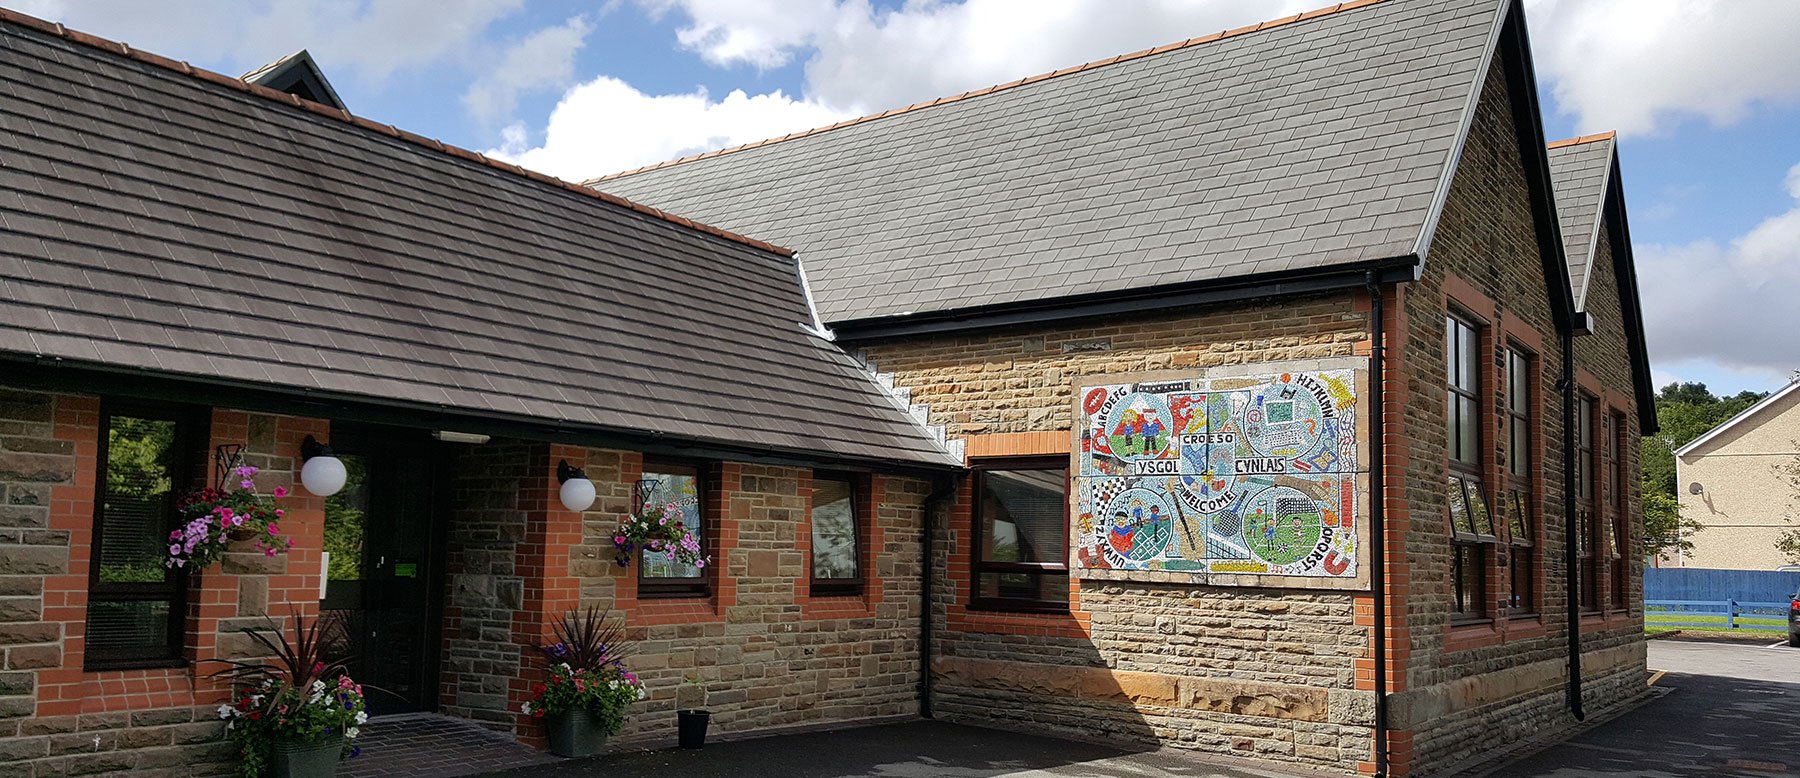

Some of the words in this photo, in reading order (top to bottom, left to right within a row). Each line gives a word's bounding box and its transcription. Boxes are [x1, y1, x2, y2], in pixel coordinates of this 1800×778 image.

[1098, 386, 1127, 427] ABCDEFG
[1297, 374, 1334, 419] HIJKLMN
[1183, 434, 1233, 444] CROESO
[1138, 460, 1179, 473] YSGOL
[1235, 458, 1285, 473] CYNLAIS
[1182, 489, 1234, 511] WELCOME
[1095, 526, 1125, 568] UVWXYZ
[1301, 527, 1333, 571] OPQRST
